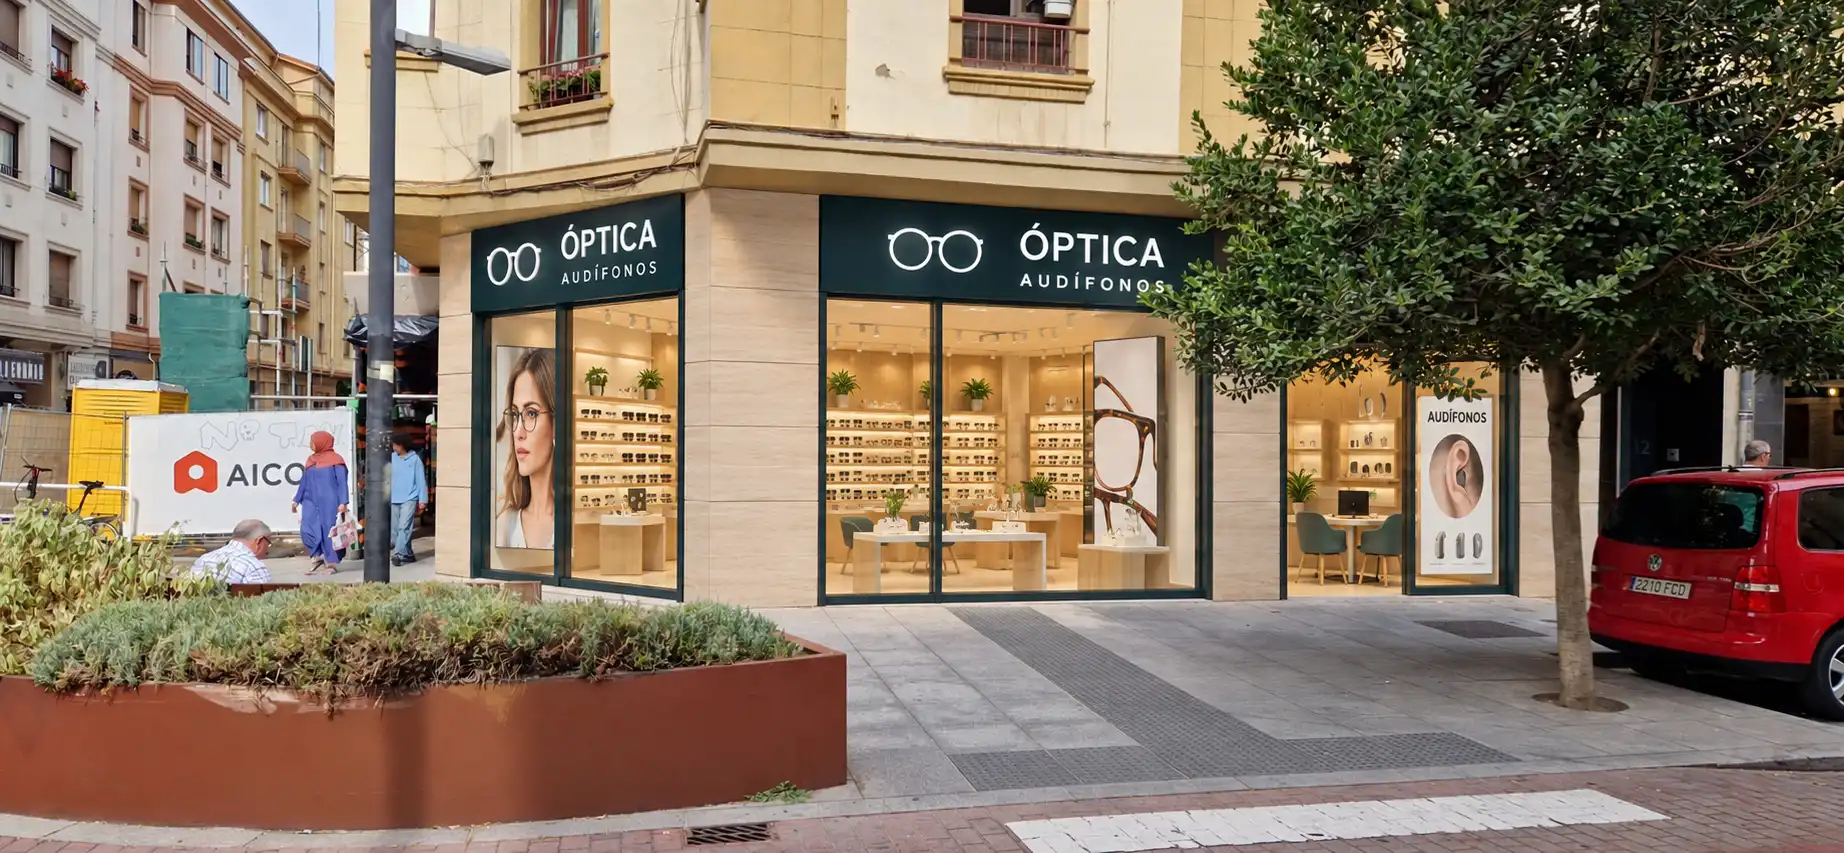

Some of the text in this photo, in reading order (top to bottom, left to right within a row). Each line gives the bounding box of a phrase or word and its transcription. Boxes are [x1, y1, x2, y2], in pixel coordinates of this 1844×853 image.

[561, 219, 657, 260] ÓPTICA
[1020, 222, 1165, 268] ÓPTICA
[561, 261, 657, 285] AUDÍFONOS
[1020, 271, 1165, 294] AUDÍFONOS
[1427, 408, 1487, 424] AUDÍFONOS
[1635, 579, 1686, 596] 2210 FCD
